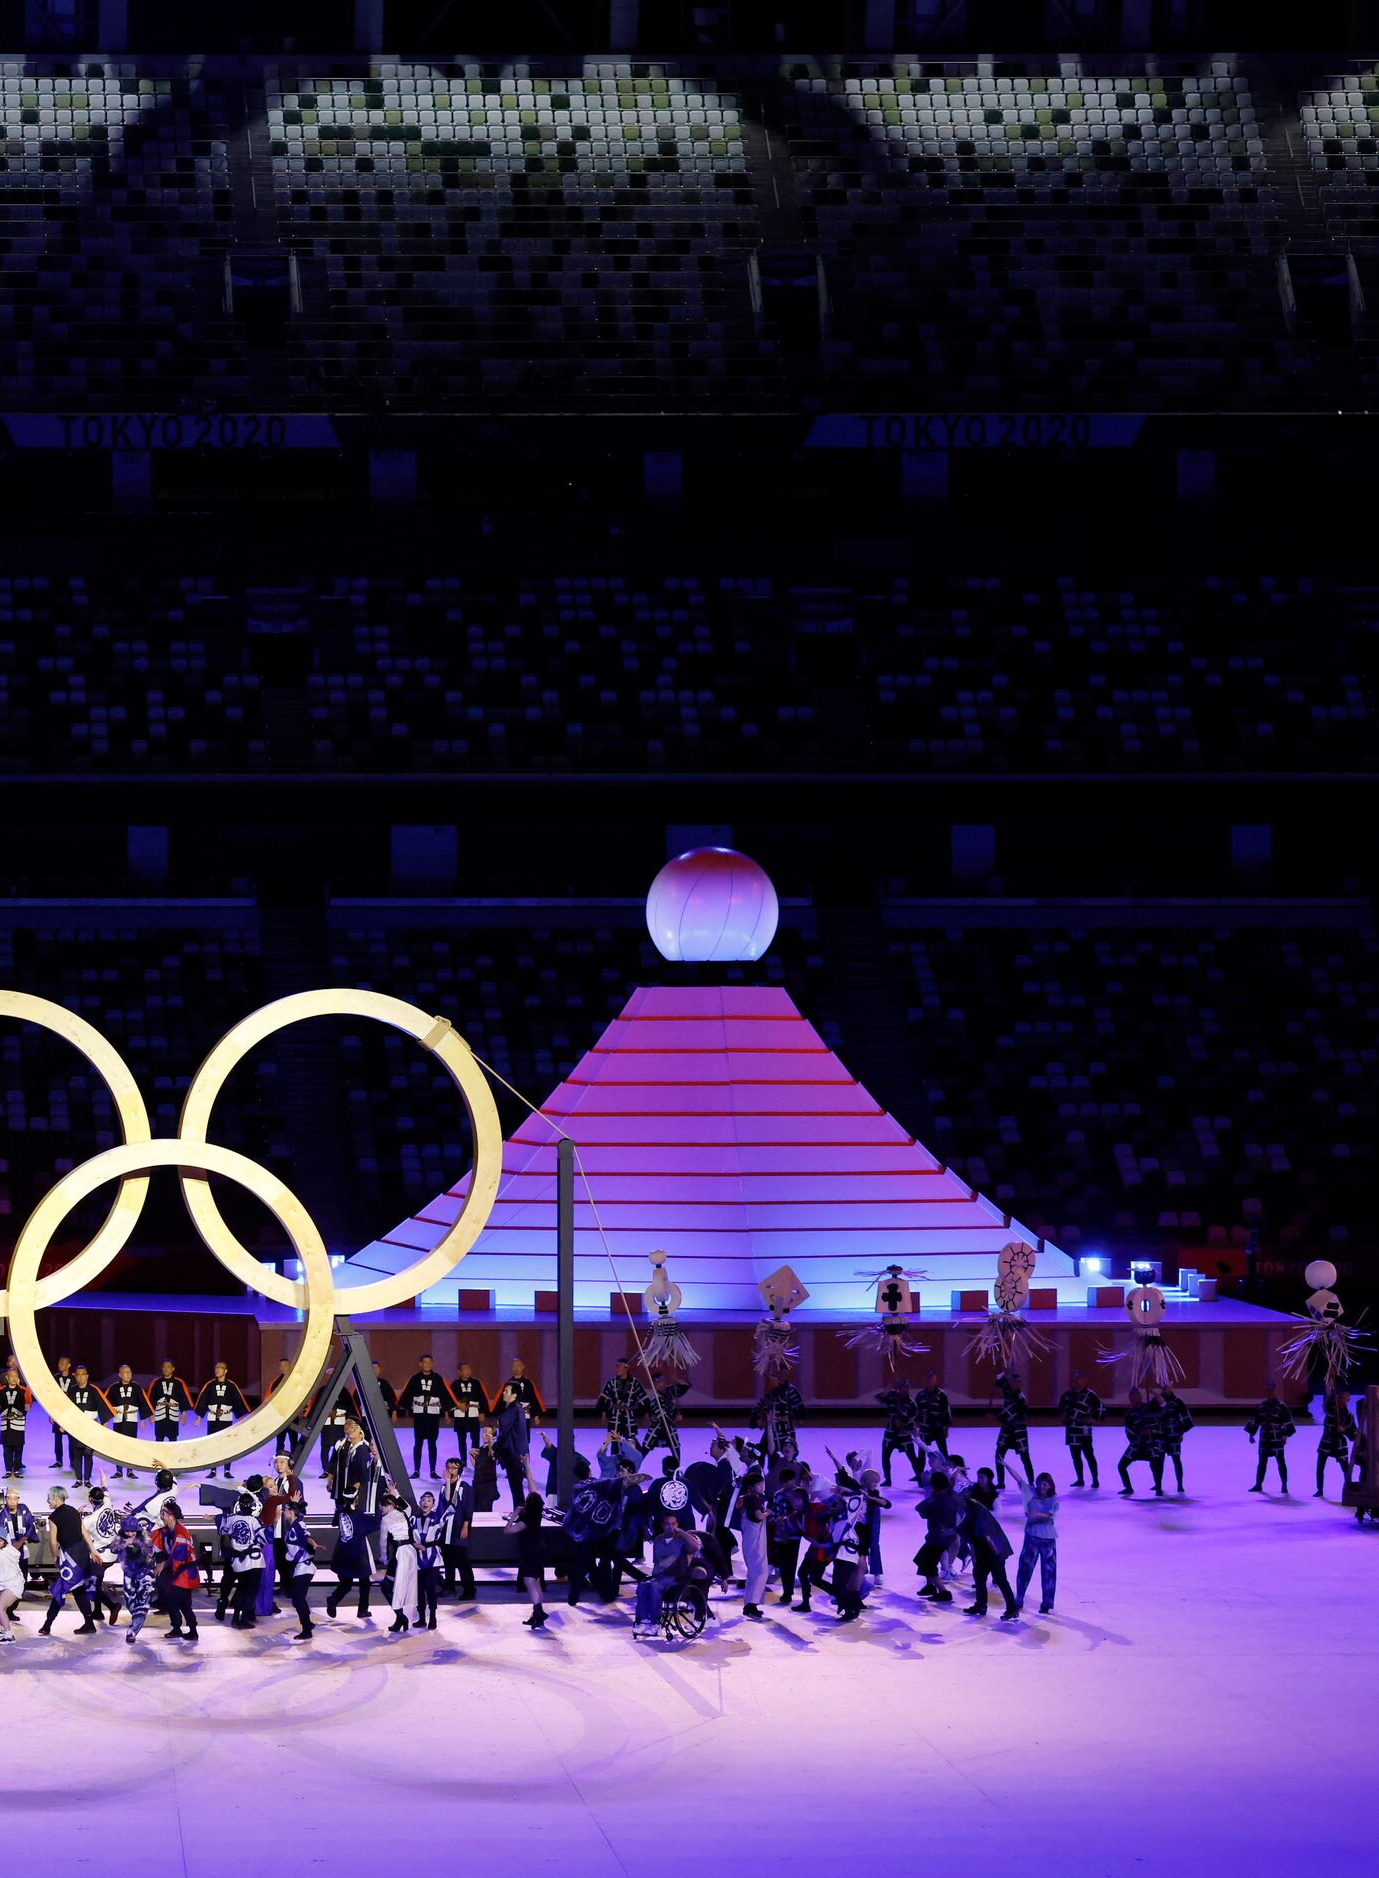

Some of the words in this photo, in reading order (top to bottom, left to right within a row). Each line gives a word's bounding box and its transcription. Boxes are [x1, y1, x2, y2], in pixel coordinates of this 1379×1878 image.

[58, 415, 183, 446] TOKYO
[196, 415, 285, 446] 2020
[860, 415, 986, 447] TOKYO
[999, 415, 1090, 447] 2020
